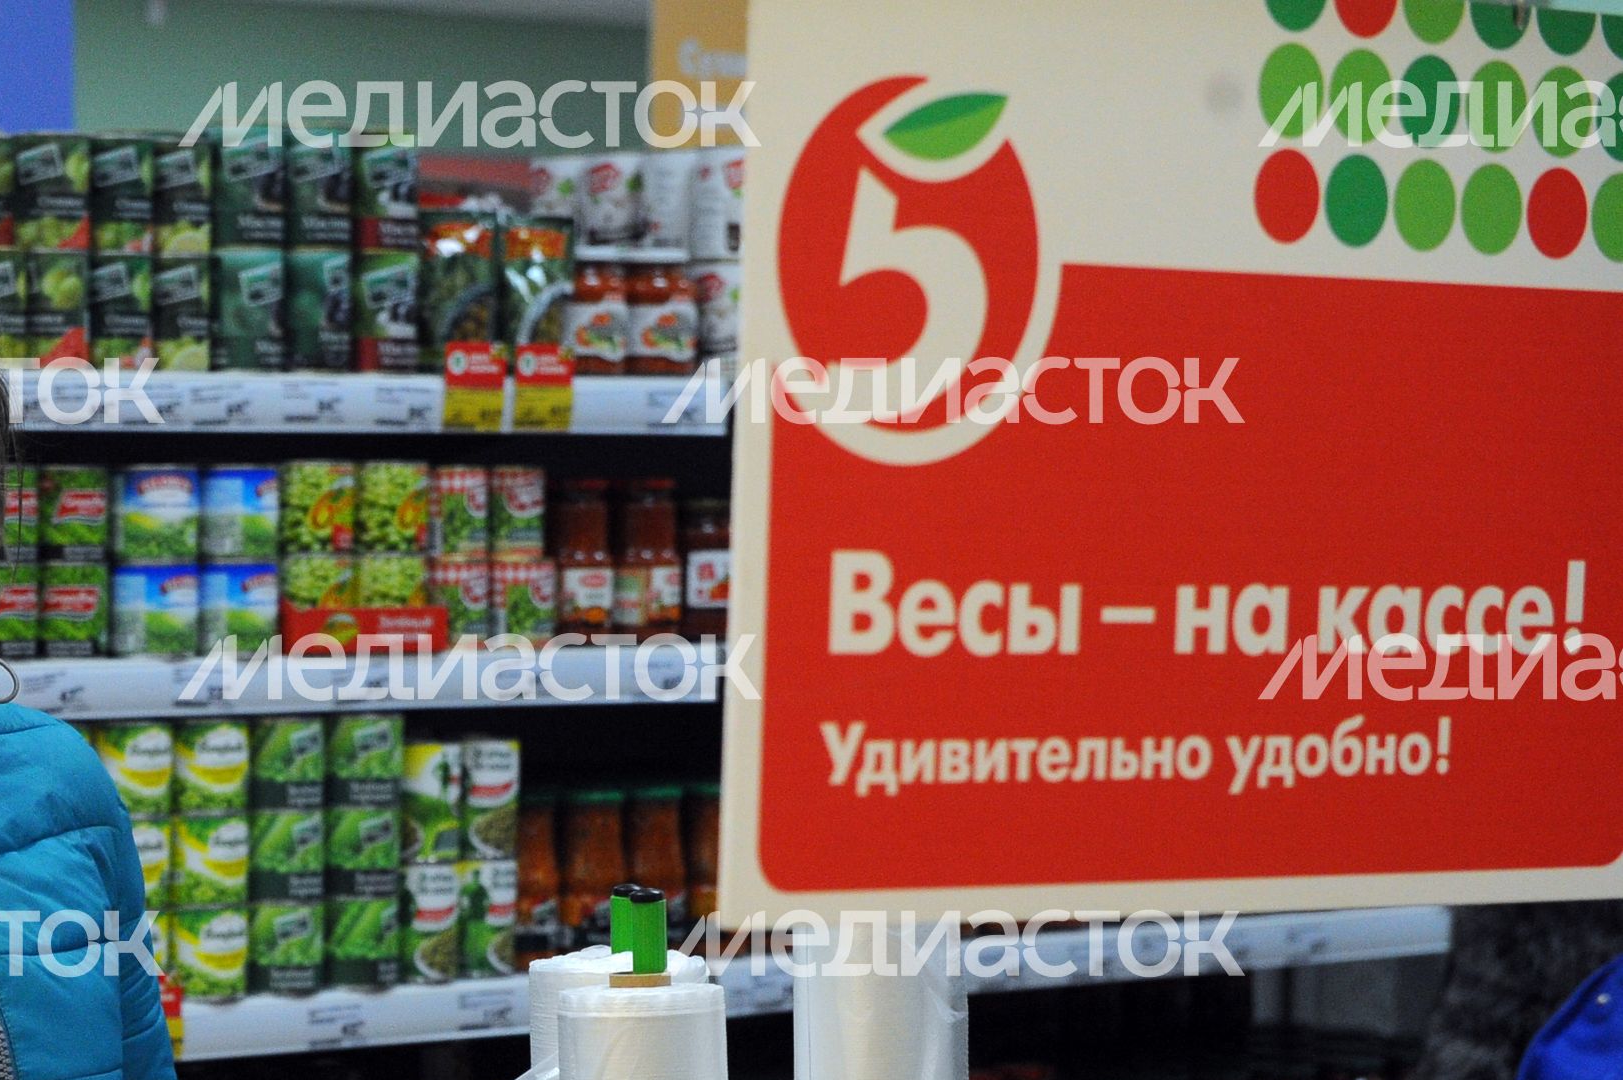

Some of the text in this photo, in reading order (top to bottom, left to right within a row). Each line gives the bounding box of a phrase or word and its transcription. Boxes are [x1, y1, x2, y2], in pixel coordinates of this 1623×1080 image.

[827, 165, 989, 418] 5
[828, 548, 1082, 660] Весы
[1174, 584, 1289, 658] на
[1318, 560, 1587, 659] кассе!
[819, 716, 1452, 797] Удивительно удобно!
